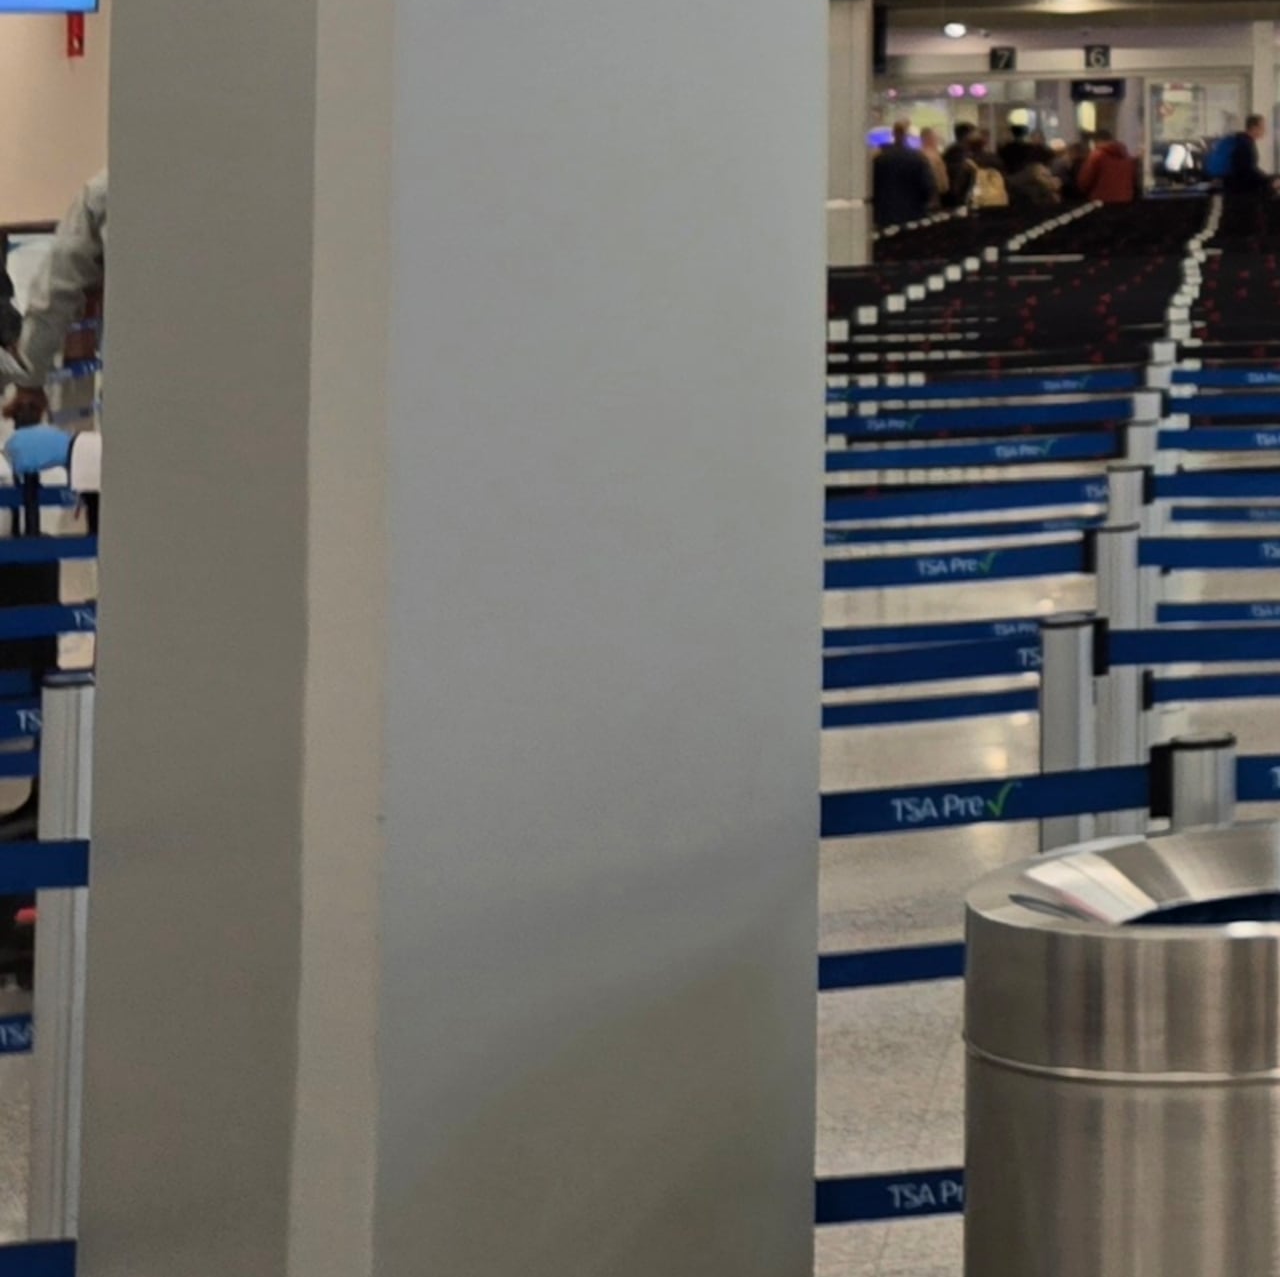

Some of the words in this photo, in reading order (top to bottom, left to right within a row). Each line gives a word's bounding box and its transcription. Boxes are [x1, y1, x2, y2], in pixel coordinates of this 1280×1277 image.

[917, 558, 948, 575] TSA
[950, 557, 978, 573] Pre
[891, 798, 939, 823] TSA
[942, 794, 985, 818] Pre
[886, 1182, 937, 1209] TSA
[940, 1179, 964, 1204] Pr
